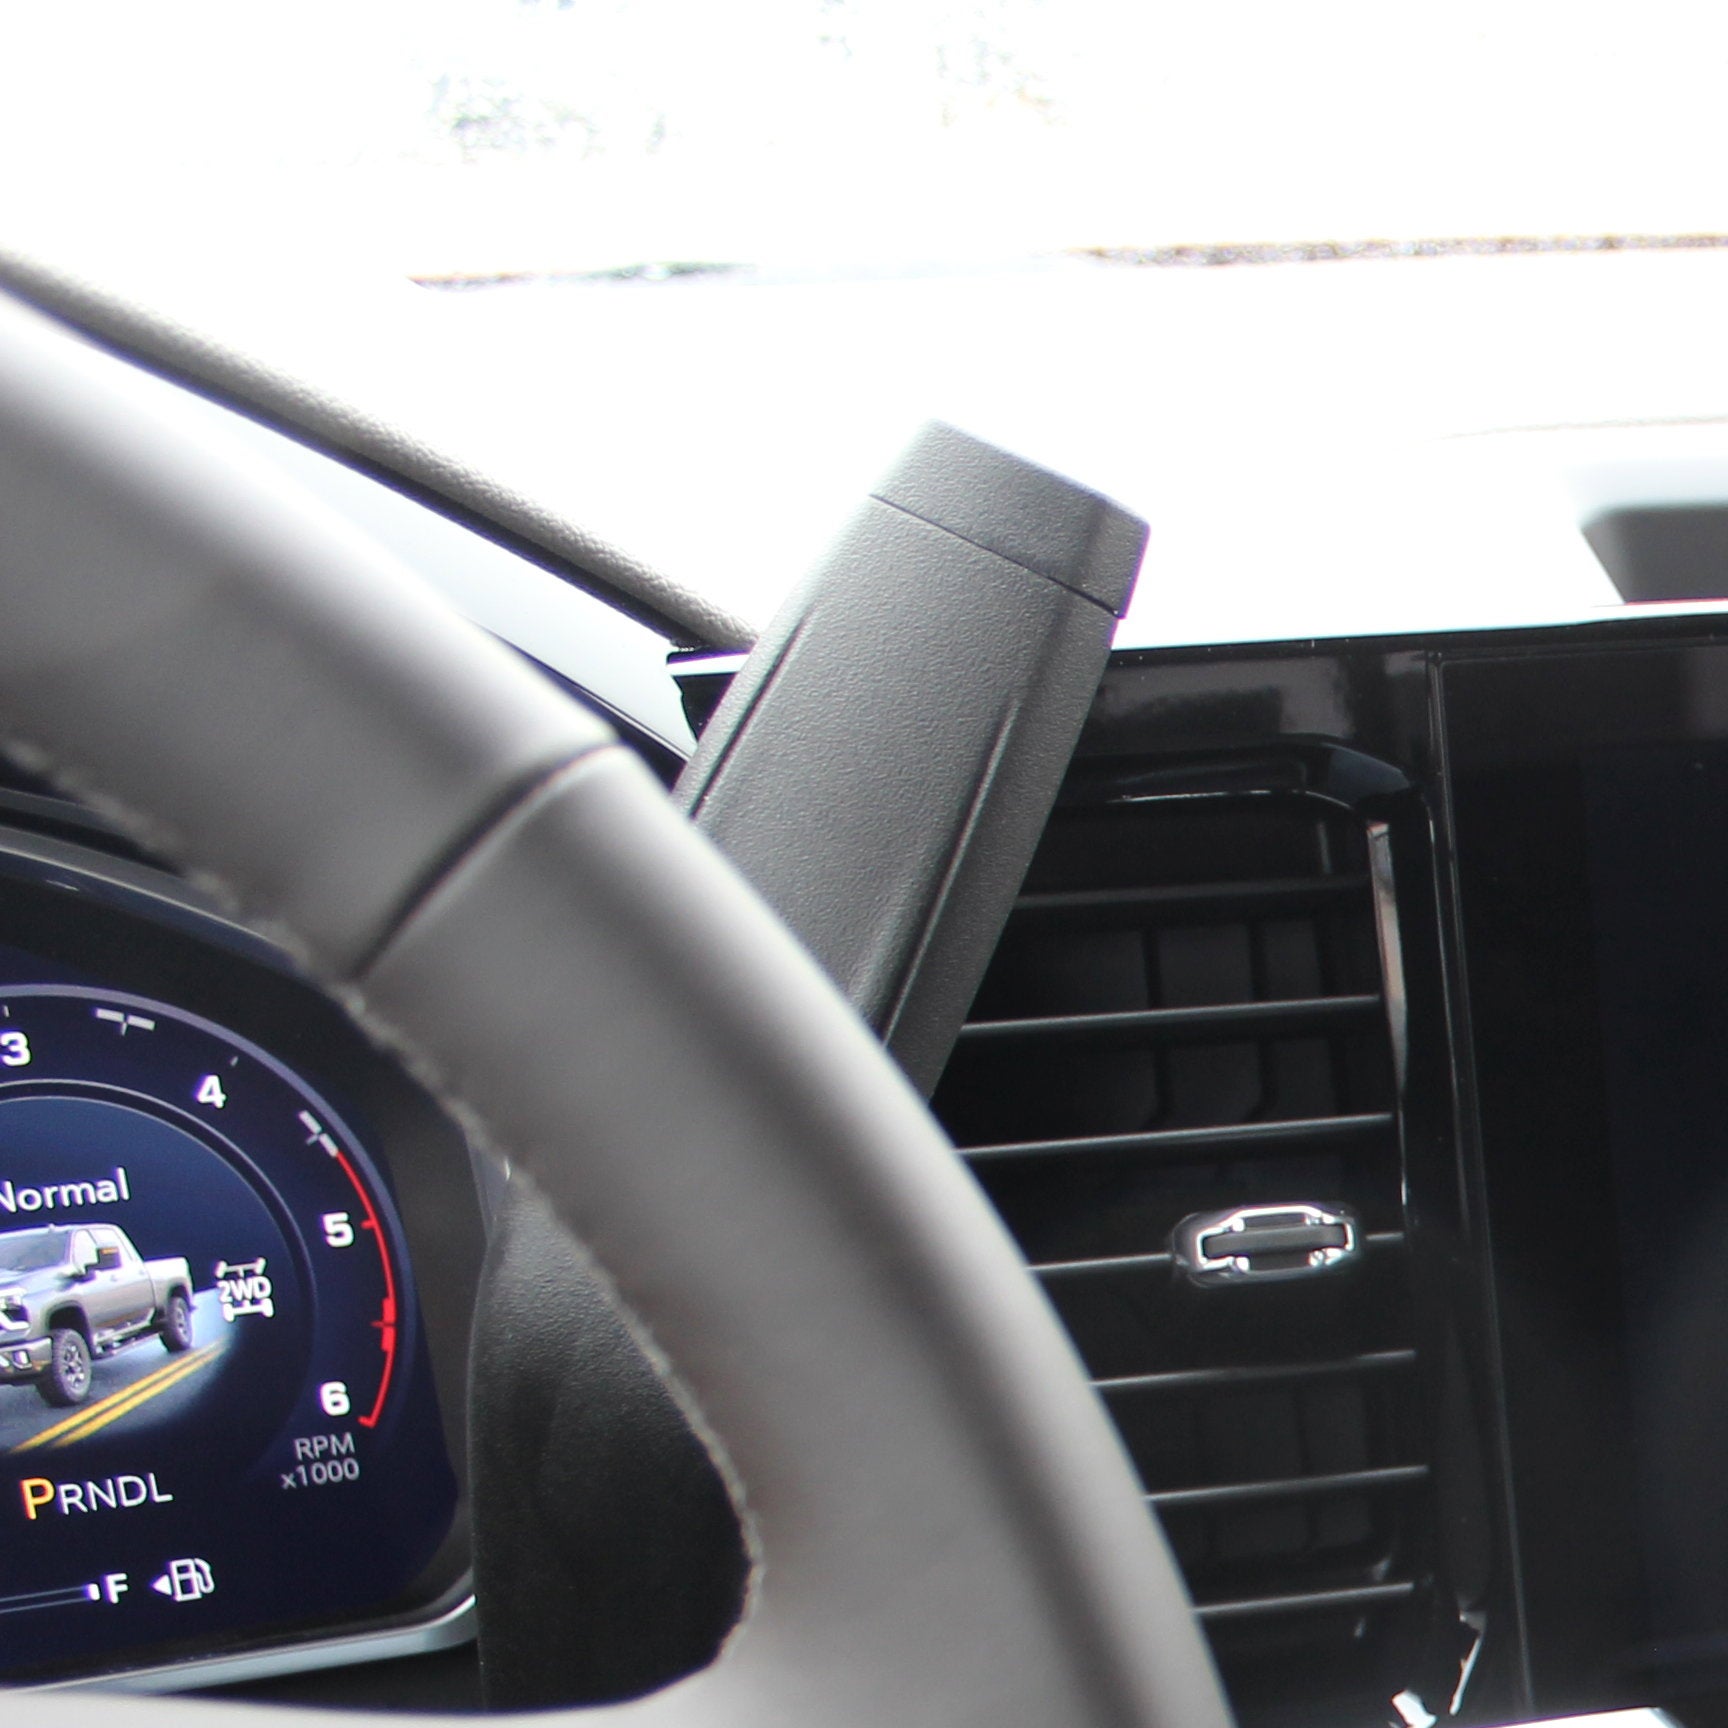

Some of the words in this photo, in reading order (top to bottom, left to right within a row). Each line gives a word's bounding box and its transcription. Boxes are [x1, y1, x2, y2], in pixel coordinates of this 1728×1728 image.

[0, 1031, 30, 1067] 3
[197, 1076, 226, 1108] 4
[322, 1212, 354, 1248] 5
[218, 1276, 272, 1304] 2WD
[320, 1381, 350, 1416] 6
[294, 1431, 356, 1461] RPM
[281, 1457, 361, 1490] x1000
[104, 1572, 129, 1604] F
